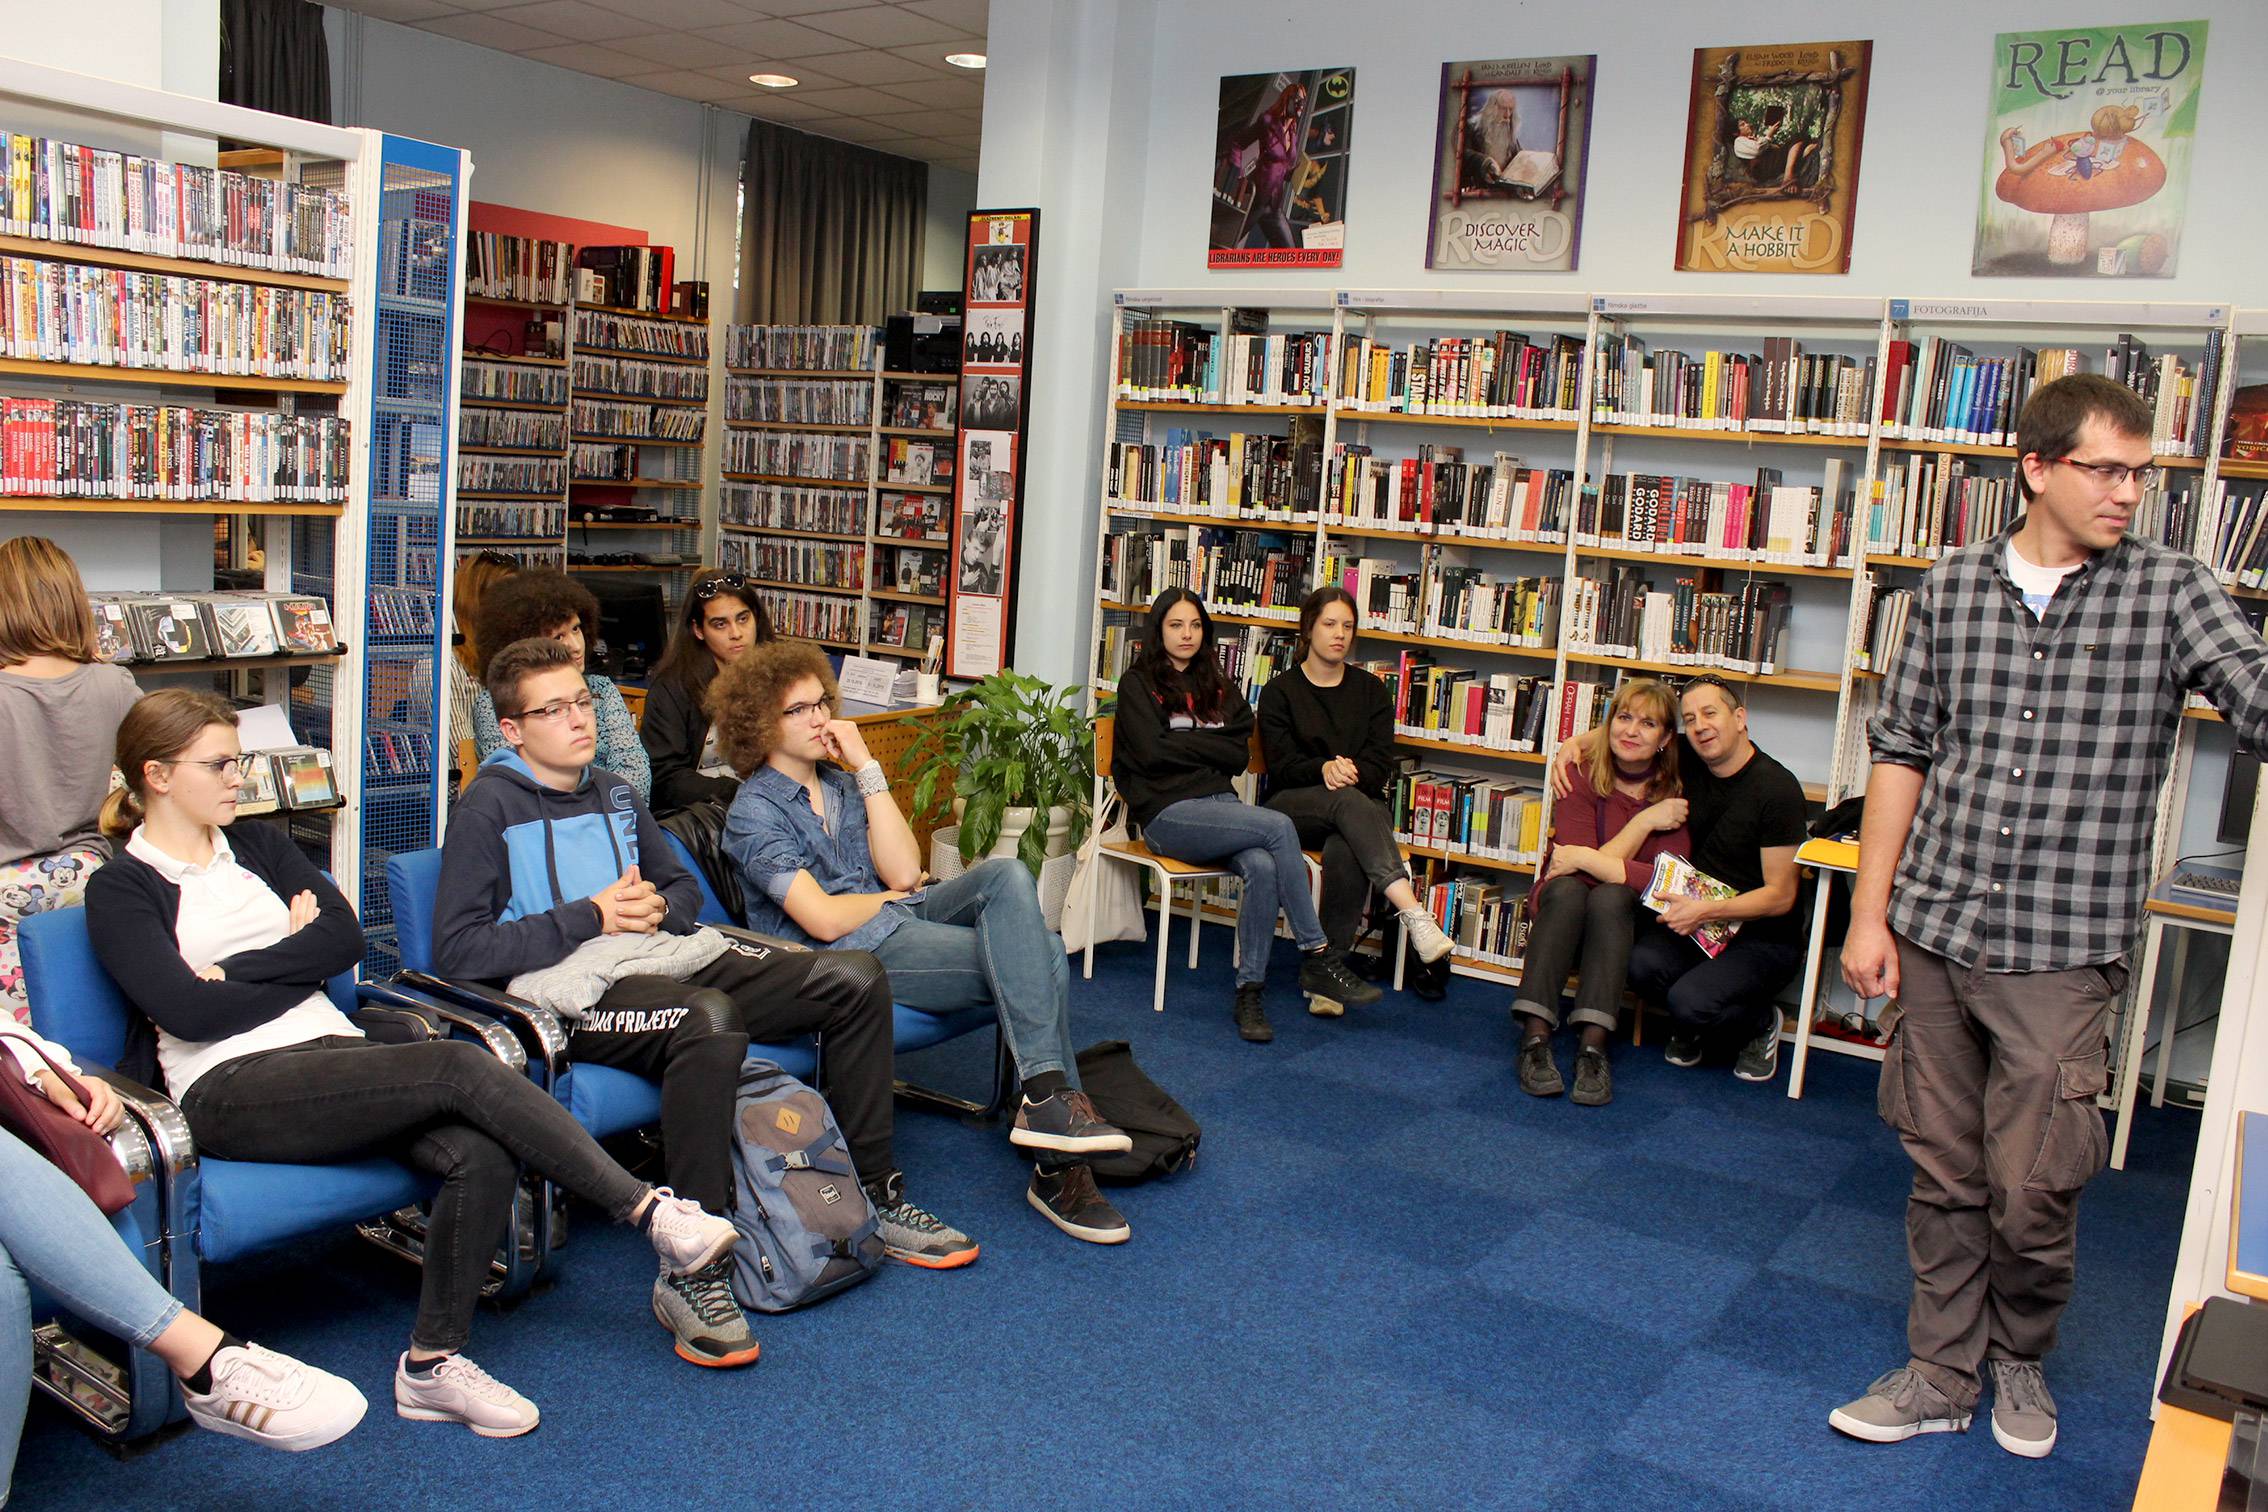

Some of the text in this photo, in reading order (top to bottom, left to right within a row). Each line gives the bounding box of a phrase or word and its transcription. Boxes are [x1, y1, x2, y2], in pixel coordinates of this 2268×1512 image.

[2006, 31, 2191, 100] READ
[2106, 87, 2128, 96] your
[2130, 85, 2161, 95] library
[1464, 223, 1540, 238] DISCOVER
[1725, 225, 1805, 242] MAKE IT
[1474, 238, 1528, 253] MAGIC
[1726, 242, 1800, 258] A HOBBIT
[1209, 250, 1341, 264] LIBRARIANS ARE HEROES EVERY DAY!
[1893, 304, 1988, 316] 77 FOTOGRAFIJA
[1633, 487, 1646, 540] GODARD
[1646, 488, 1659, 541] GODARD
[1564, 685, 1576, 715] OPRAH
[1436, 798, 1450, 806] FILM
